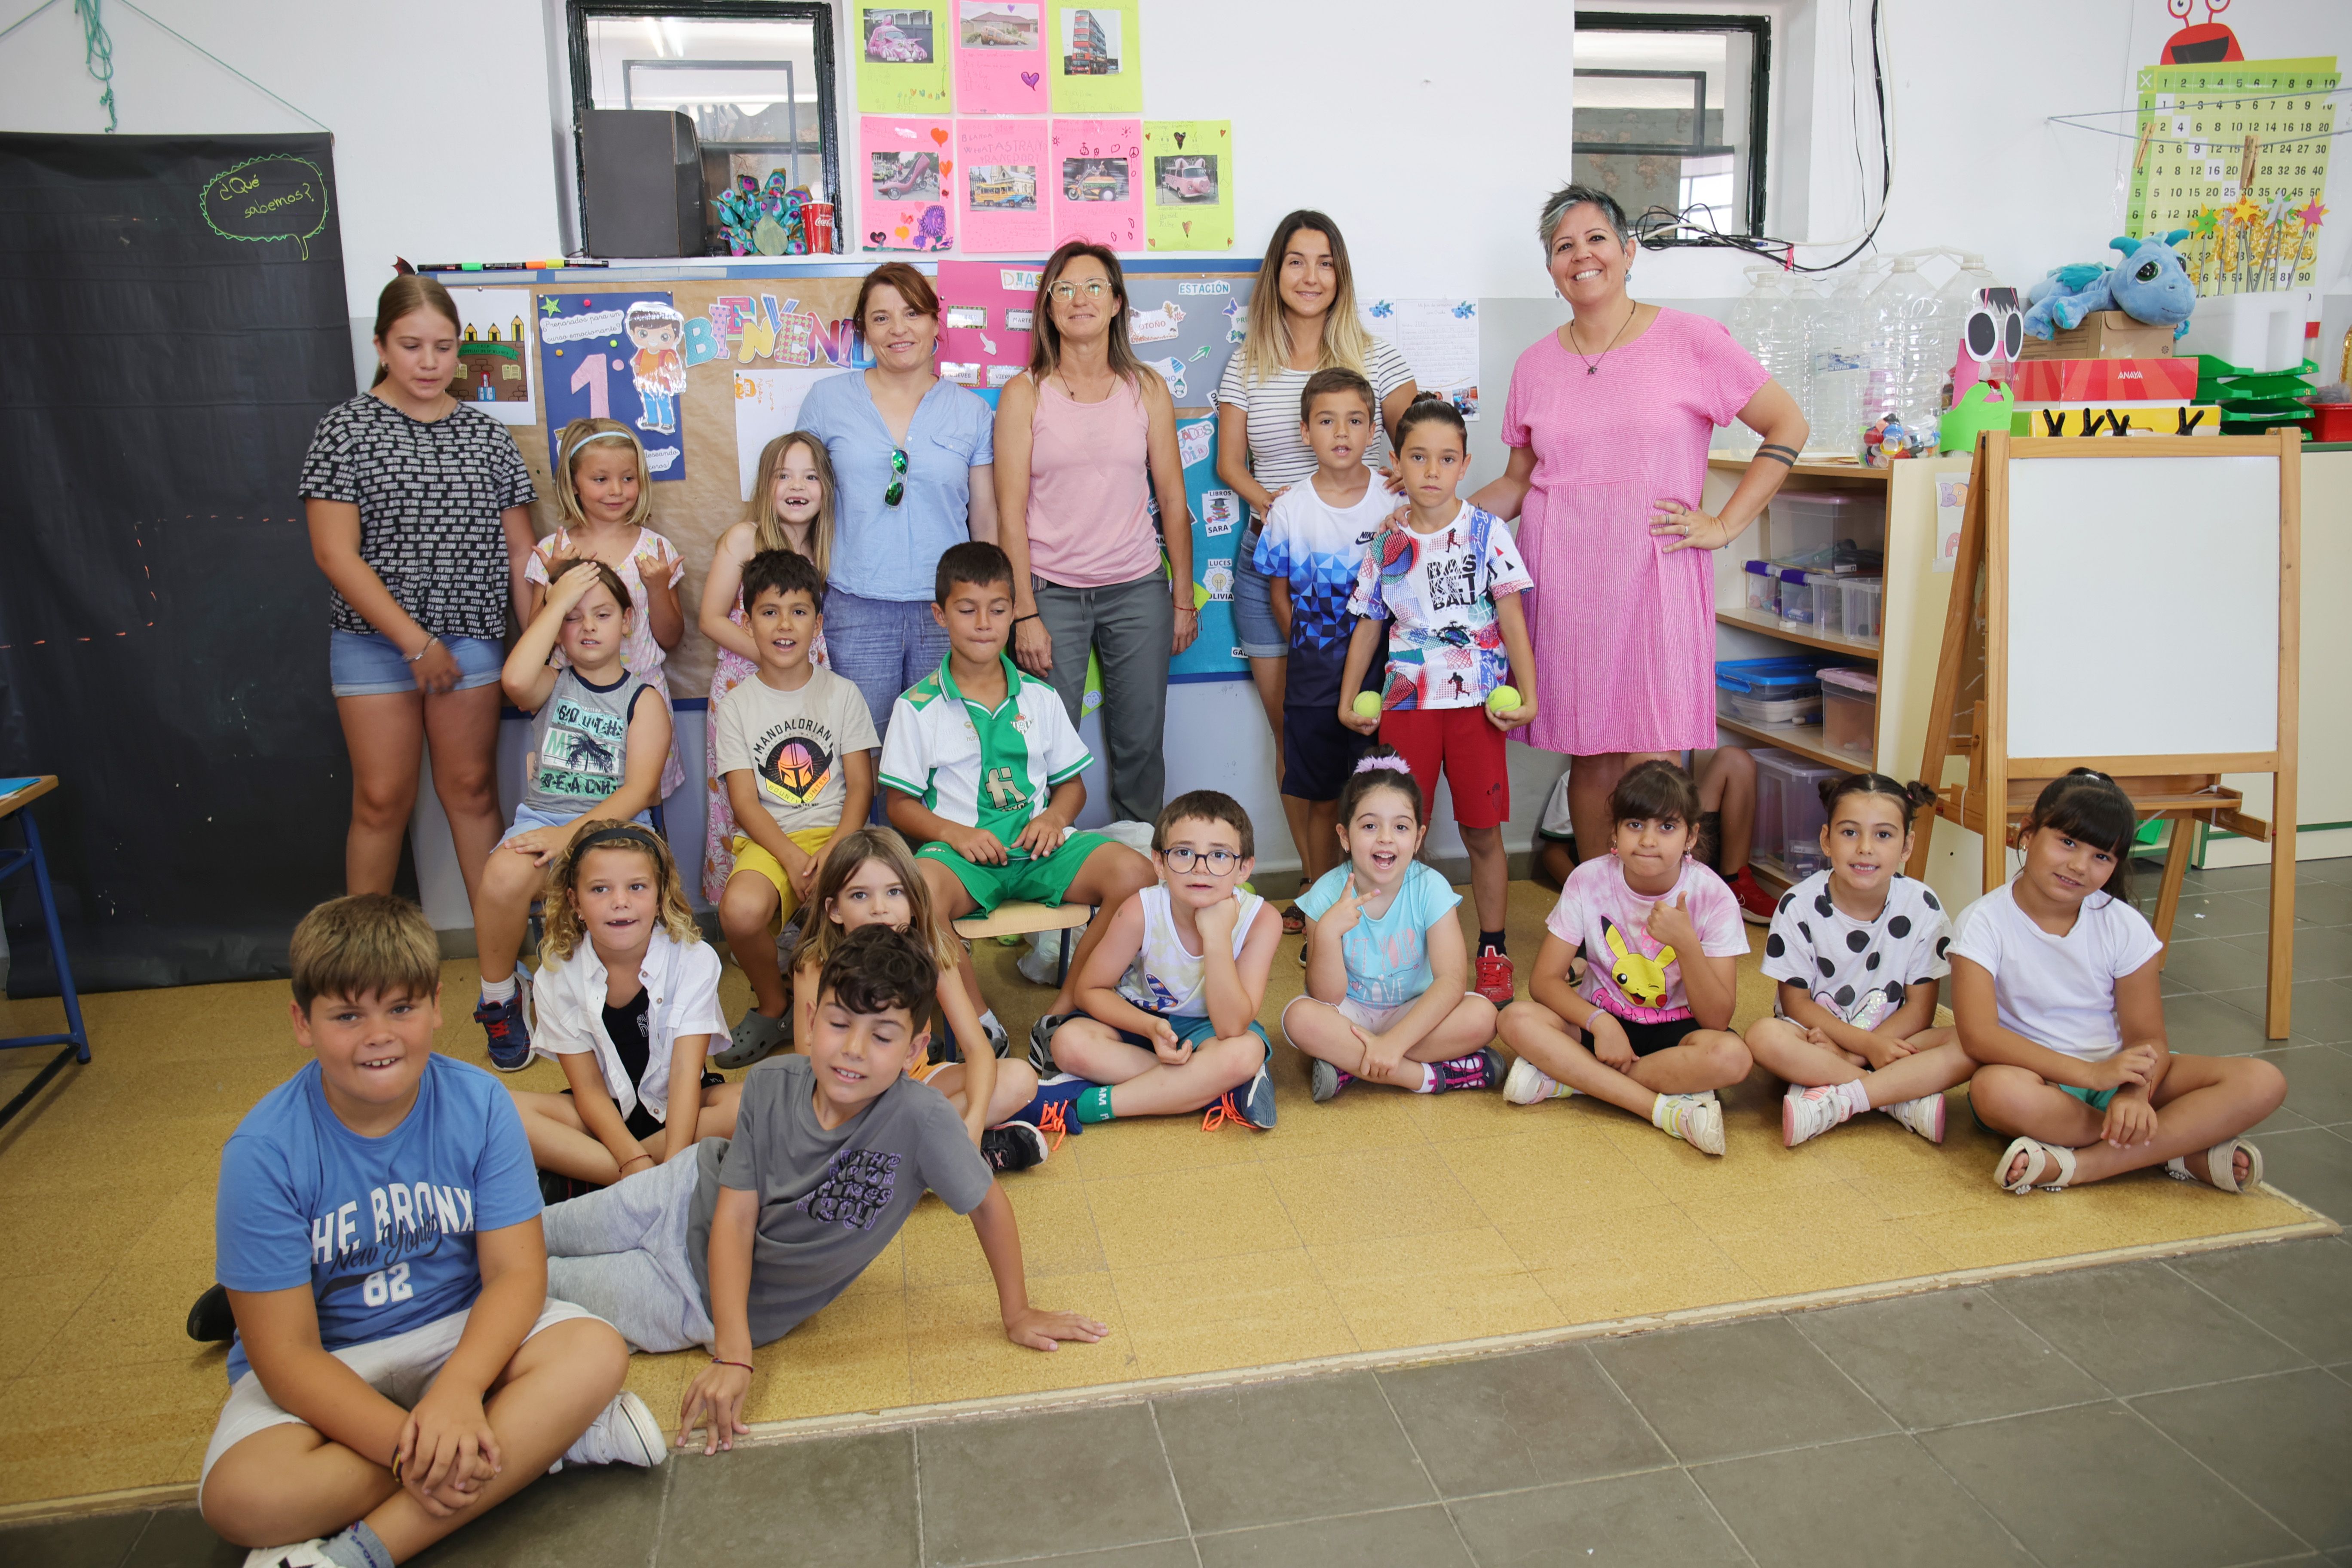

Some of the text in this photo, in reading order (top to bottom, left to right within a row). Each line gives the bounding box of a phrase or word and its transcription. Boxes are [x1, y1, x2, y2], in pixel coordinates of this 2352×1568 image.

[2163, 79, 2168, 87] 1
[2181, 79, 2187, 87] 2
[2200, 79, 2205, 88] 3
[2218, 79, 2223, 87] 4
[2237, 79, 2242, 87] 5
[2254, 79, 2259, 87] 6
[2272, 80, 2277, 88] 7
[2289, 80, 2294, 88] 8
[2307, 80, 2312, 88] 9
[2179, 101, 2185, 109] 2
[2198, 101, 2203, 110] 3
[2217, 101, 2223, 109] 4
[2236, 101, 2240, 109] 5
[2253, 101, 2258, 109] 6
[2271, 101, 2275, 110] 7
[2288, 101, 2293, 110] 8
[2305, 101, 2310, 110] 9
[2160, 122, 2165, 131] 2
[2178, 123, 2183, 131] 4
[2196, 123, 2202, 131] 6
[2215, 122, 2220, 131] 8
[2232, 122, 2242, 131] 10
[2248, 122, 2260, 131] 12
[2266, 123, 2276, 132] 14
[2282, 122, 2294, 131] 16
[2301, 123, 2311, 132] 18
[2319, 123, 2329, 132] 20
[2159, 145, 2164, 153] 3
[2177, 145, 2182, 153] 6
[2194, 144, 2200, 153] 9
[2209, 144, 2222, 153] 12
[2261, 144, 2274, 153] 21
[2280, 145, 2291, 153] 24
[2297, 145, 2309, 153] 27
[2316, 145, 2326, 153] 30
[2156, 166, 2162, 175] 4
[2175, 166, 2180, 175] 8
[2191, 166, 2201, 175] 12
[2209, 166, 2220, 175] 16
[2226, 166, 2238, 175] 20
[2261, 166, 2272, 175] 28
[2278, 166, 2289, 175] 32
[2295, 166, 2306, 175] 36
[2313, 166, 2323, 175] 40
[220, 174, 260, 200] ¿Qué
[2135, 189, 2141, 197] 5
[2154, 189, 2159, 197] 5
[2171, 188, 2182, 196] 10
[2190, 188, 2200, 196] 15
[2206, 188, 2218, 196] 20
[2224, 188, 2236, 196] 25
[2241, 188, 2253, 196] 30
[2259, 188, 2269, 196] 35
[2292, 188, 2303, 196] 45
[245, 183, 315, 219] sabemos?
[2132, 211, 2138, 219] 6
[2151, 210, 2156, 219] 6
[2187, 210, 2198, 218] 18
[2231, 273, 2242, 281] 54
[2299, 273, 2310, 281] 90
[1179, 281, 1229, 294] ESTACIÓN
[543, 315, 588, 332] ¿Preparados
[590, 314, 608, 324] para
[1139, 319, 1166, 331] OTOÑO
[547, 323, 621, 343] curso emocionante?
[2118, 371, 2143, 379] ANAYA
[1208, 525, 1229, 533] SARA
[559, 705, 618, 736] SOUTH
[753, 718, 832, 754] MANDALORIAN
[544, 773, 610, 794] BEACH
[769, 777, 828, 803] BOUNTY HUNTER
[1378, 928, 1421, 972] YOUR
[371, 1182, 474, 1243] BRONX
[330, 1245, 379, 1274] New
[363, 1261, 414, 1307] 82
